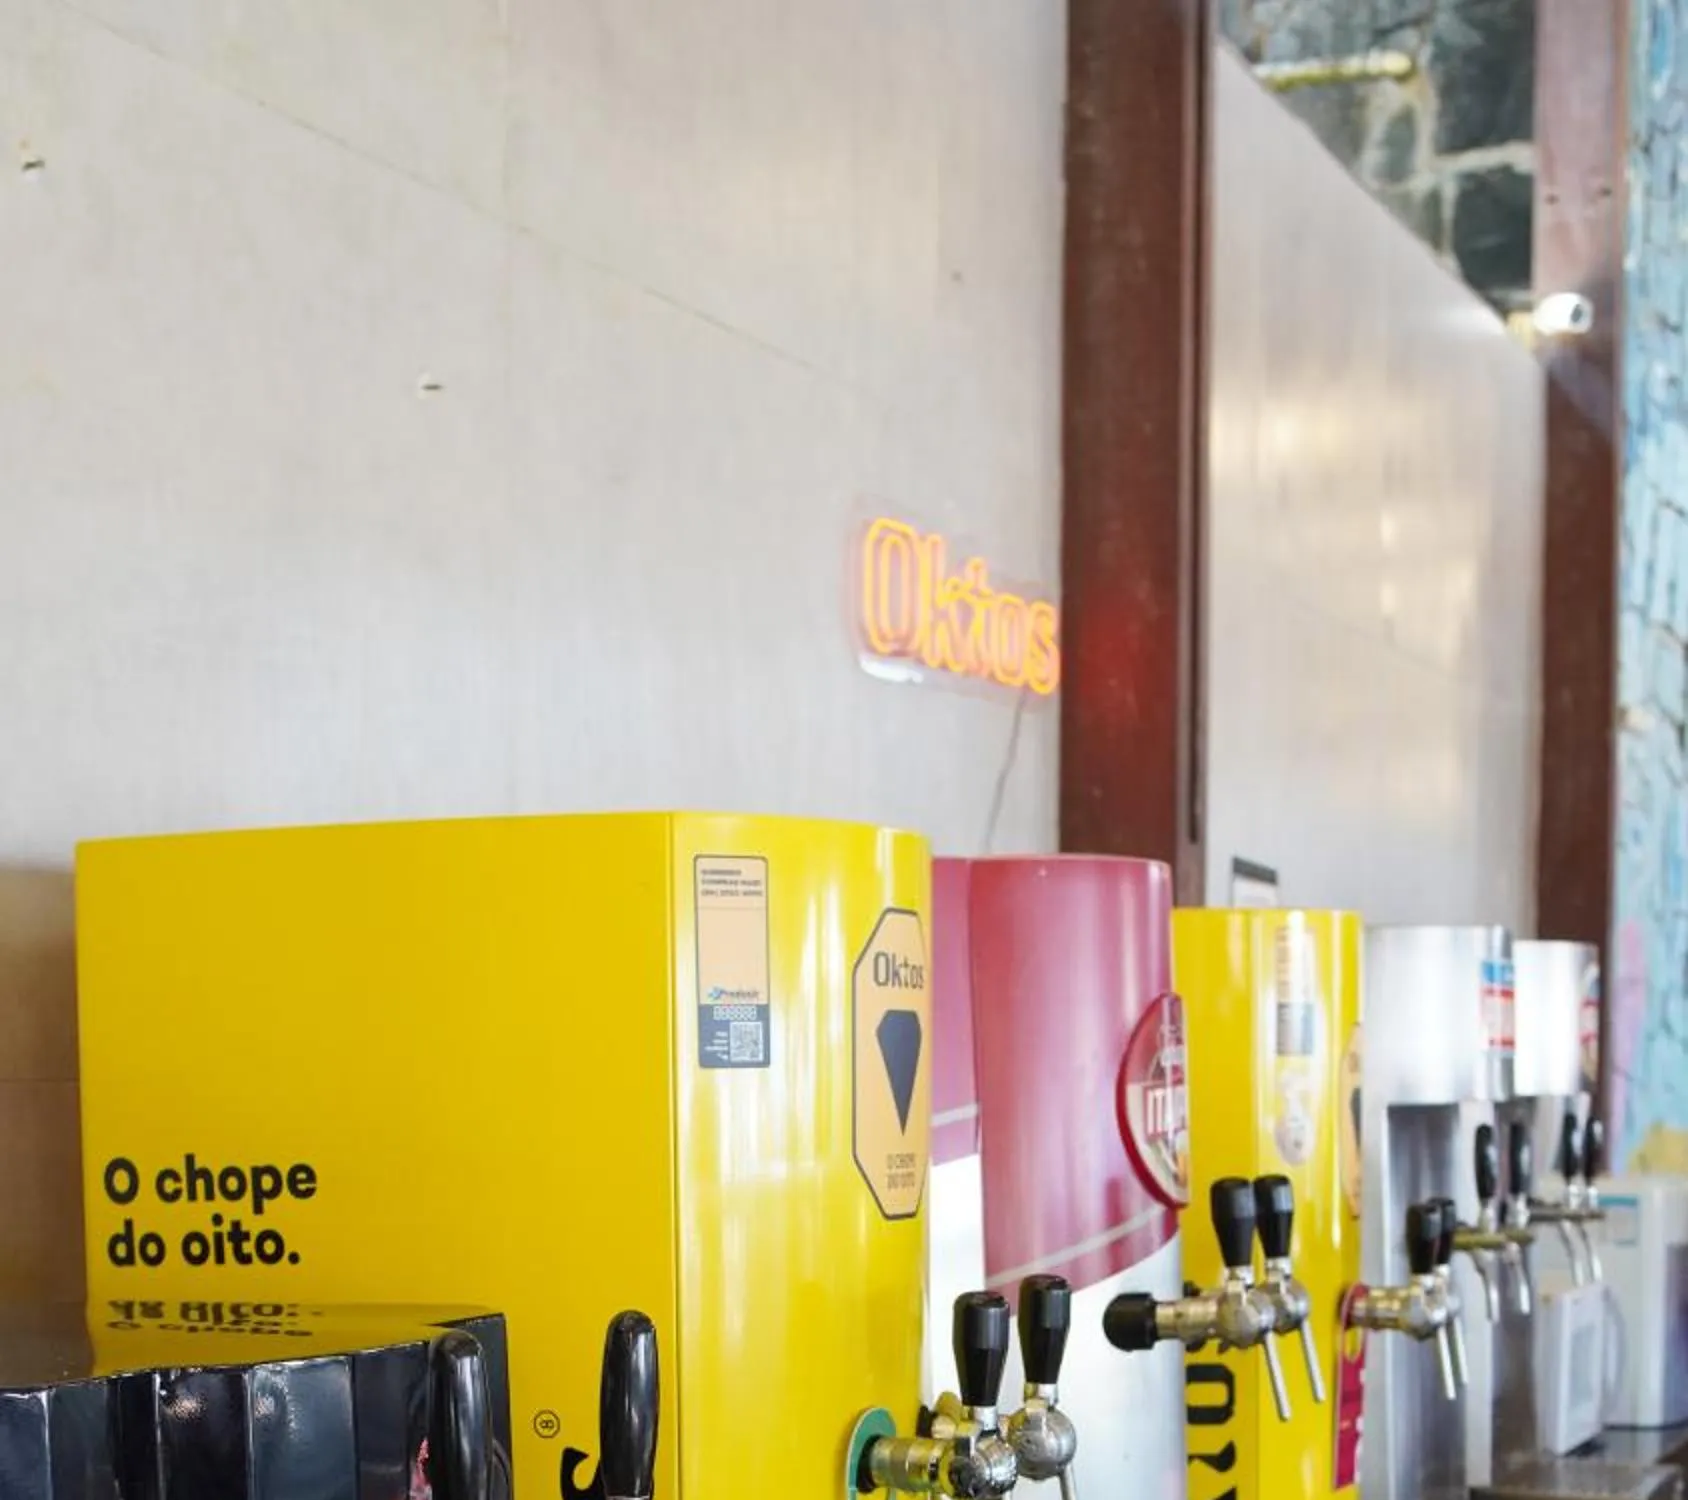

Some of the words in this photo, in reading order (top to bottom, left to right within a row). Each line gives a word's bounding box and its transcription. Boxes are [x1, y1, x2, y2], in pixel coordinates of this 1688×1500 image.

[864, 517, 1060, 694] Oktos
[872, 951, 925, 991] Oktos
[104, 1158, 139, 1205] O
[156, 1153, 318, 1215] chope
[107, 1218, 166, 1267] do
[181, 1212, 300, 1266] oito.
